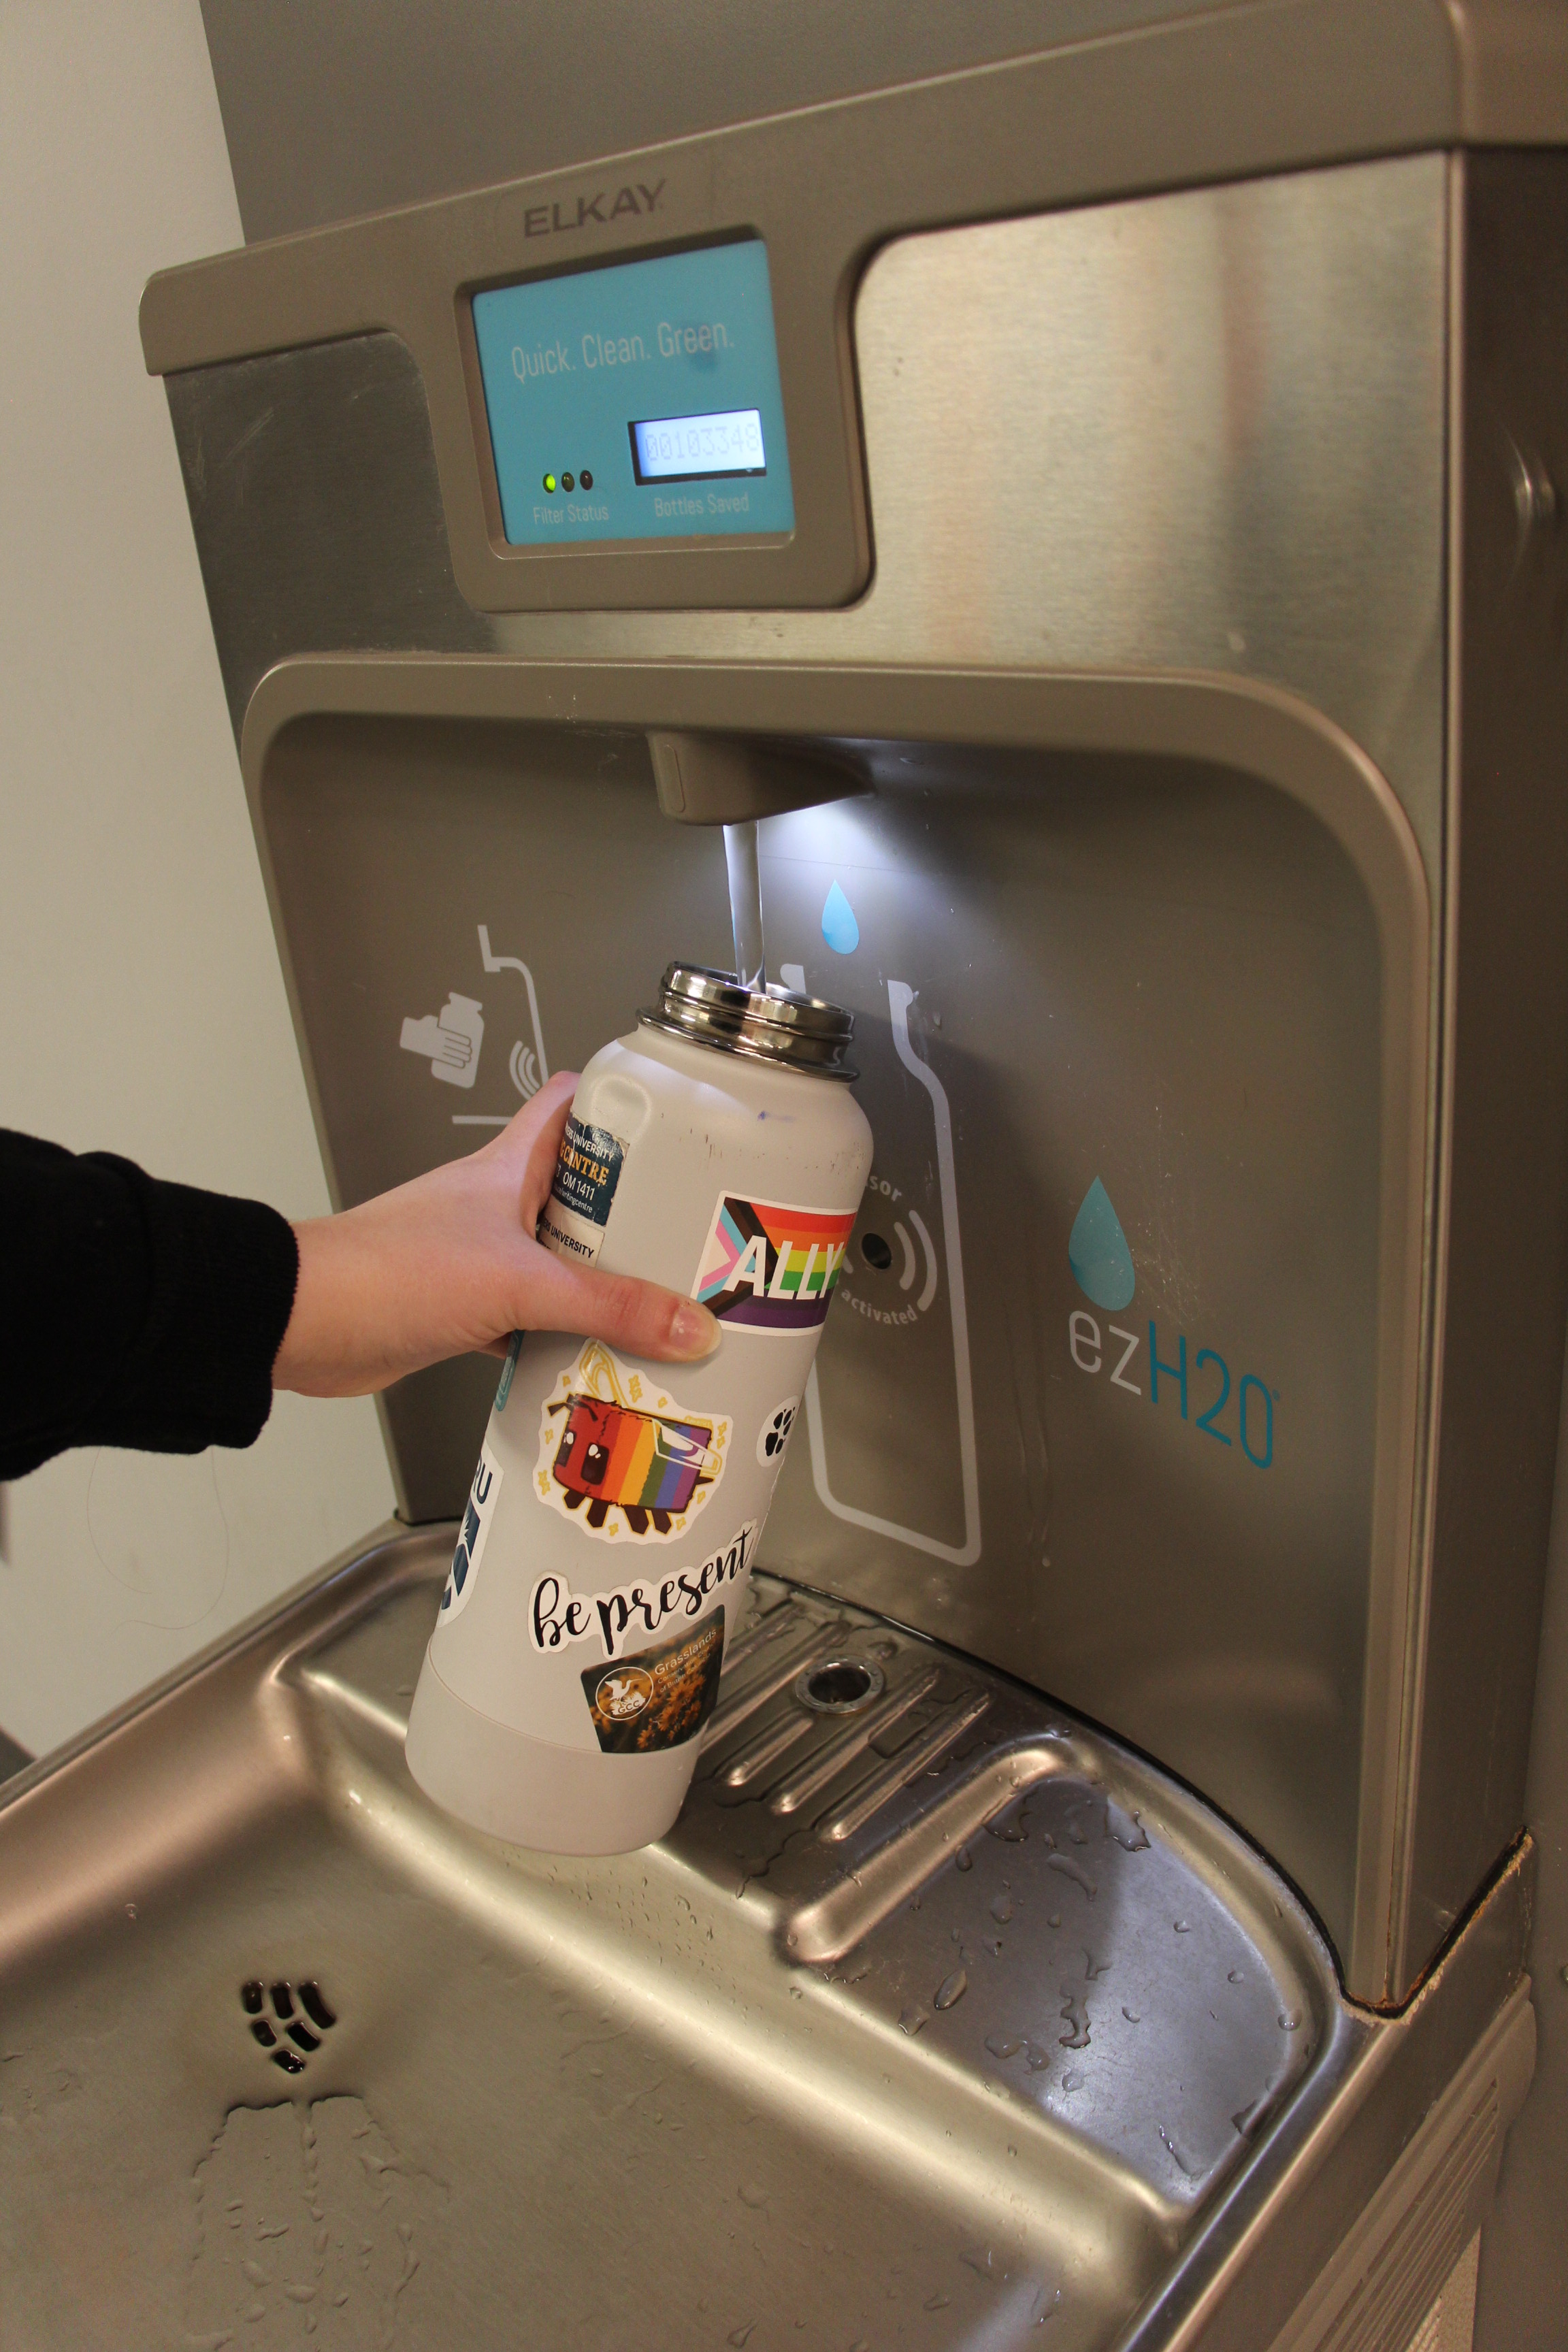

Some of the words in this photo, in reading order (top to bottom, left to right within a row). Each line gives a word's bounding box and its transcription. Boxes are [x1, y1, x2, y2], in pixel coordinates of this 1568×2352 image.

[523, 178, 667, 238] ELKAY
[512, 340, 576, 385] Quick.
[583, 334, 651, 369] Clean.
[657, 321, 734, 358] Green.
[646, 423, 760, 461] 00103348
[534, 504, 564, 525] Filter
[568, 502, 609, 522] Status
[654, 495, 704, 517] Bottles
[707, 491, 749, 514] Saved
[573, 1130, 615, 1162] UNIVERSITY
[563, 1171, 576, 1190] OM
[576, 1180, 595, 1200] 1411
[551, 1226, 595, 1258] UNIVERSITY
[722, 1235, 845, 1300] ALLY
[840, 1288, 917, 1325] activated
[533, 1577, 591, 1648] be
[596, 1526, 755, 1655] present
[655, 1629, 717, 1675] Grasslands
[659, 1684, 667, 1693] of
[617, 1699, 640, 1714] GCC
